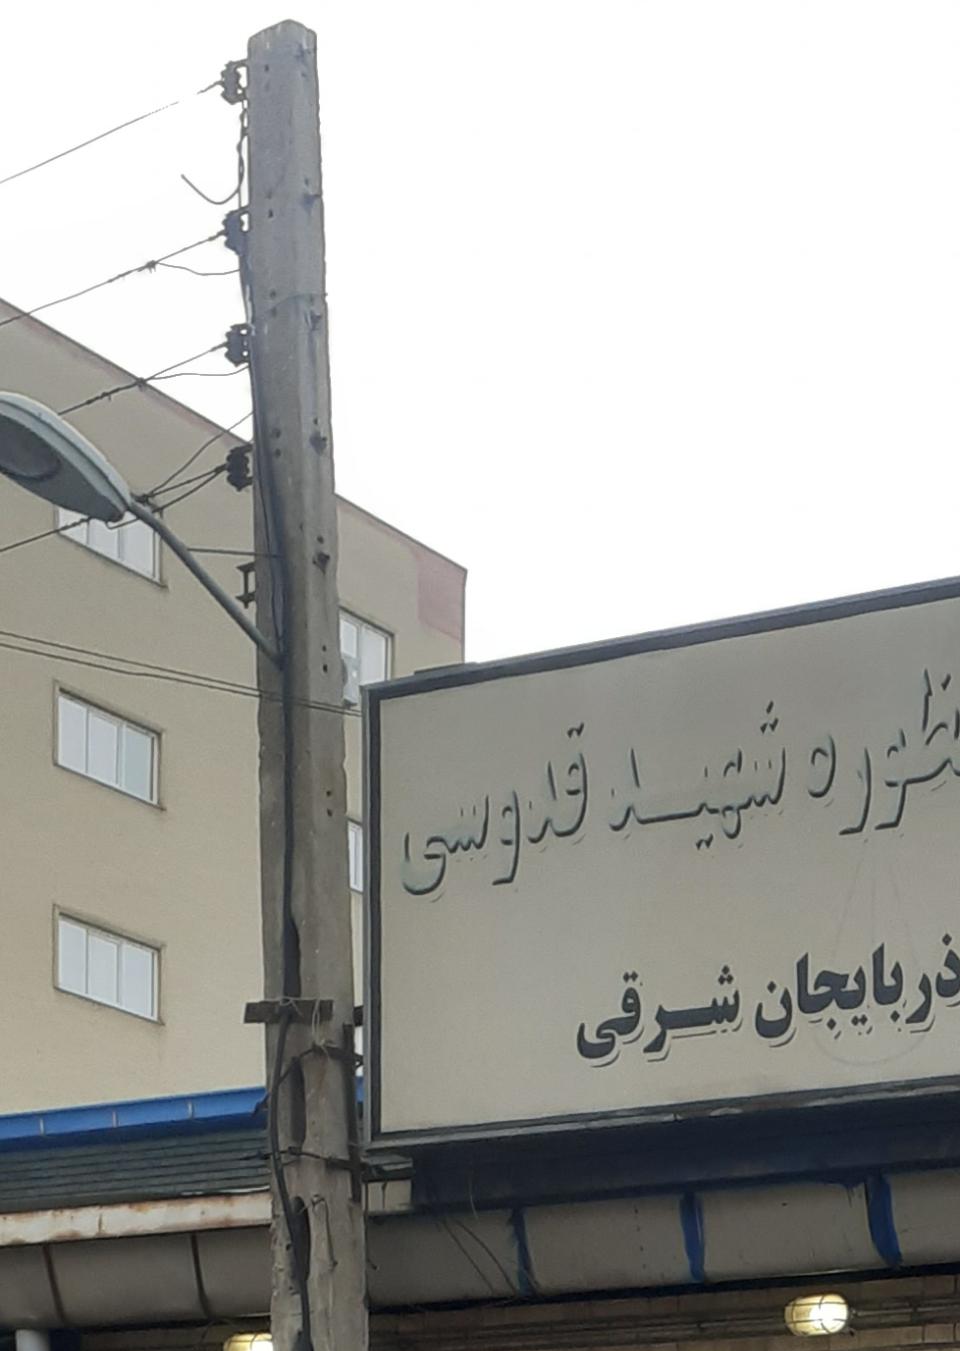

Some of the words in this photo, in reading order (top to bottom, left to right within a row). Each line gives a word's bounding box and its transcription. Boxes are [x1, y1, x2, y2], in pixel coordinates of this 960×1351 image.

[402, 722, 590, 900] قدوسی
[608, 700, 786, 852] شهید
[576, 965, 742, 1068] شرقی
